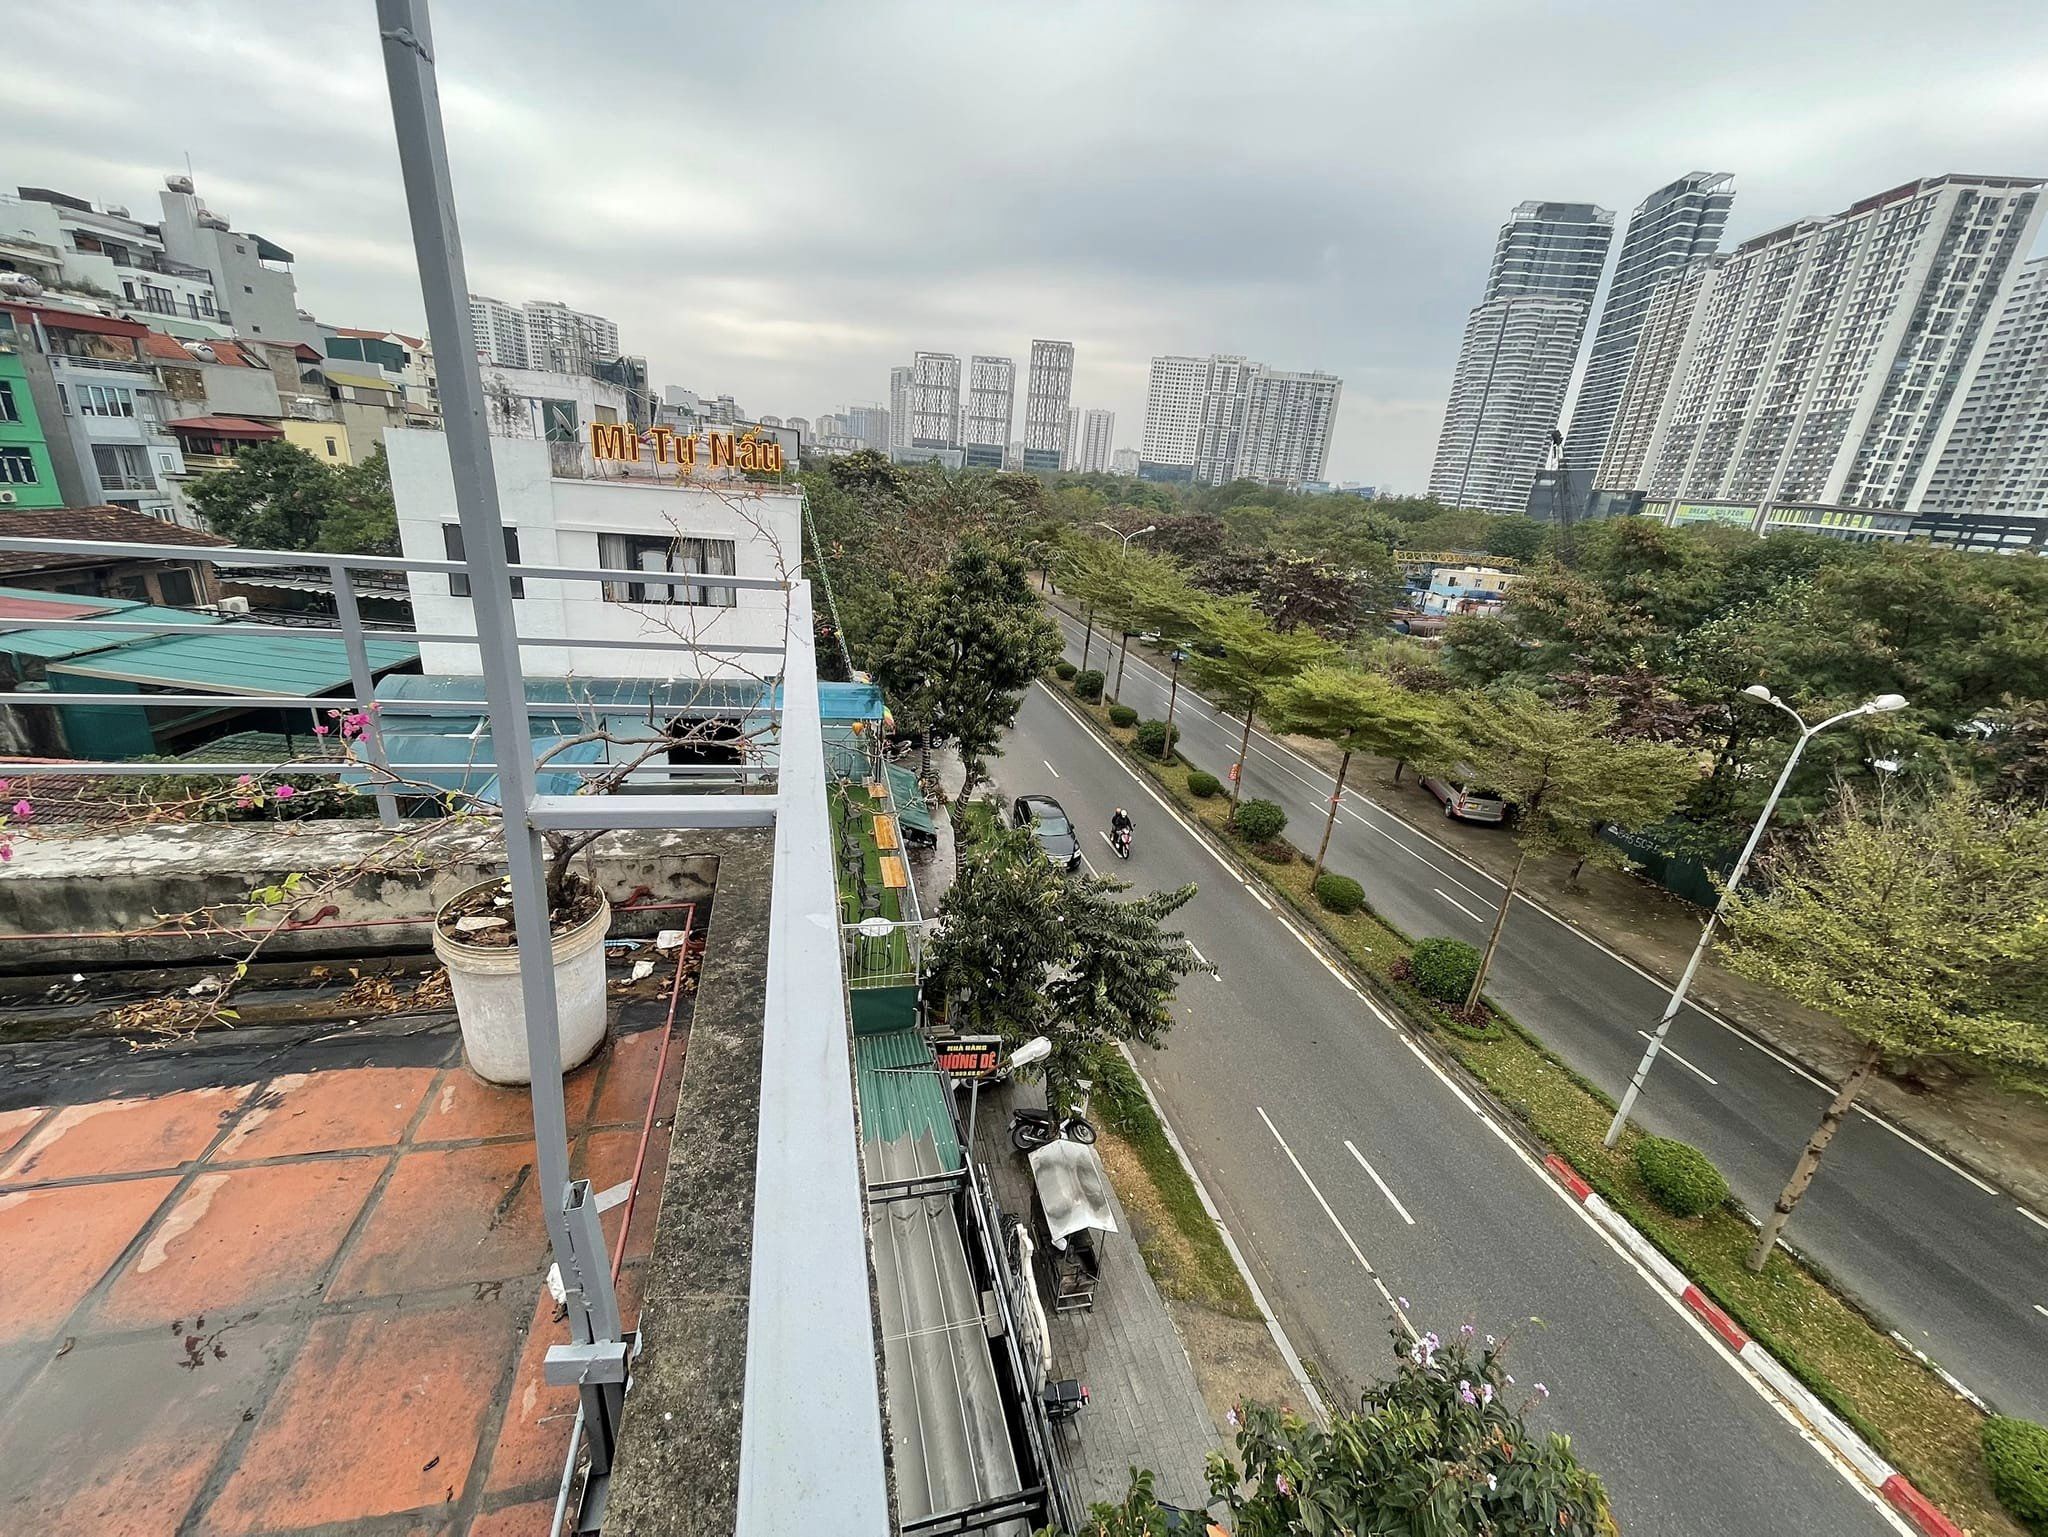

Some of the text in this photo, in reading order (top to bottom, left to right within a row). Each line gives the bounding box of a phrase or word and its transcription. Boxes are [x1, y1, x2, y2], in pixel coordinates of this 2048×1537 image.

[590, 422, 781, 473] Mì Tự Nấu
